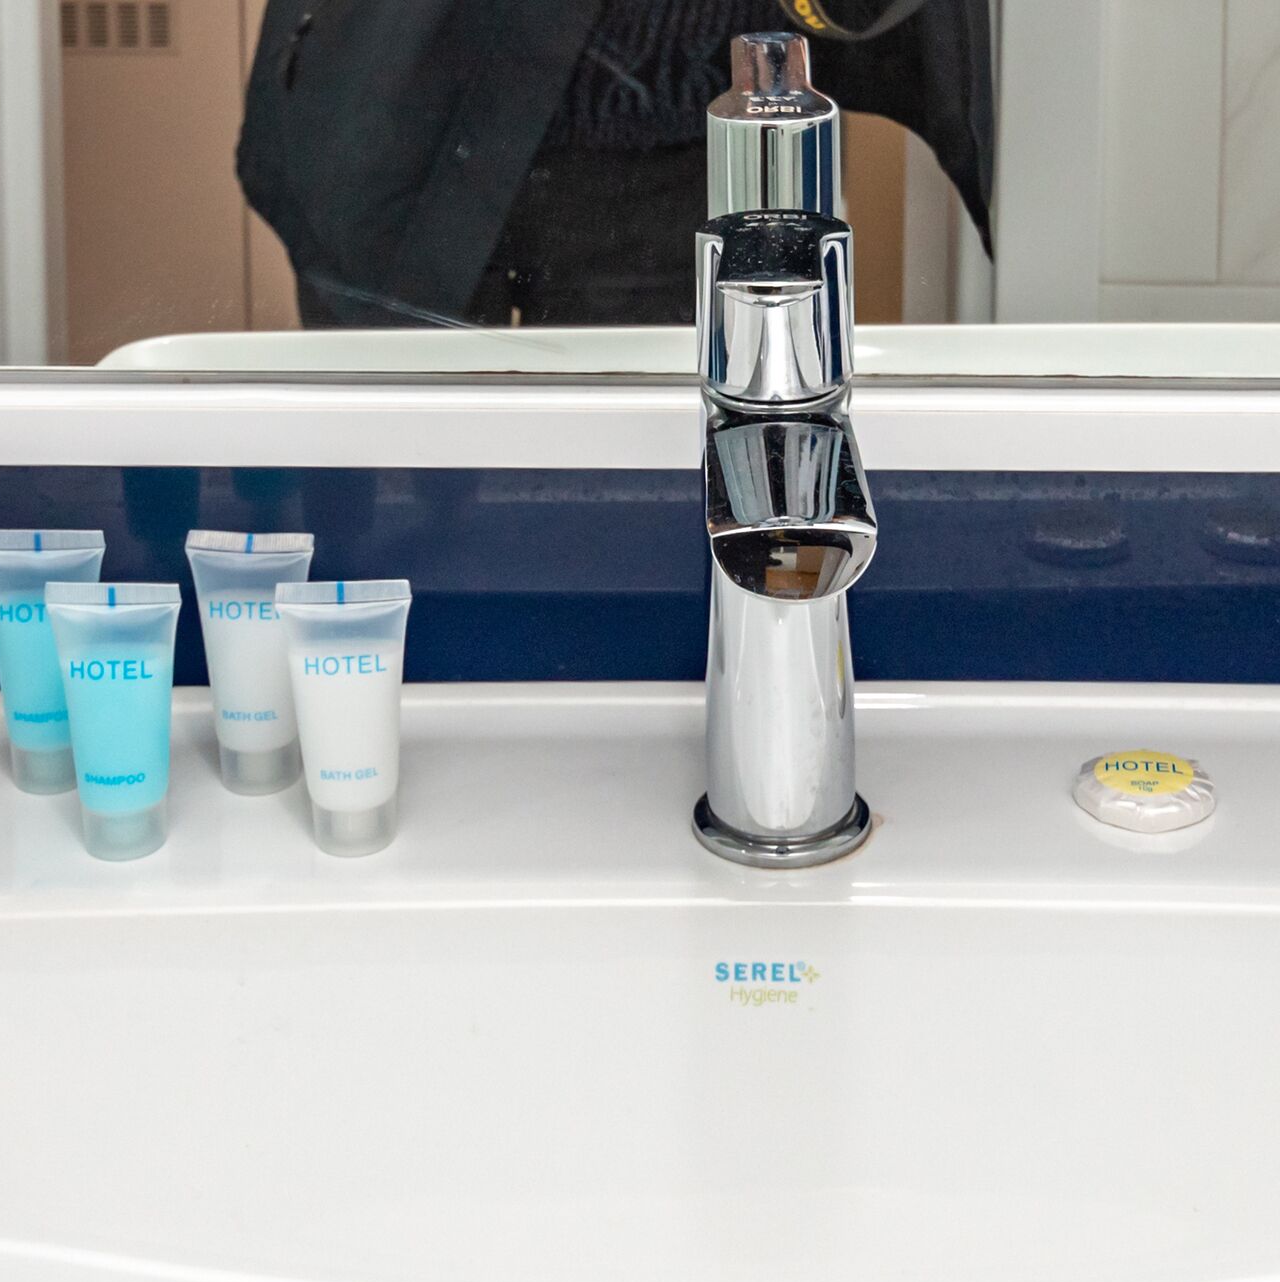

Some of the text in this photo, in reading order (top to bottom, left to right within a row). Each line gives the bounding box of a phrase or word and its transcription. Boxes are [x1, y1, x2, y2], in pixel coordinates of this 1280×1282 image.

[0, 603, 47, 623] HOT
[70, 660, 153, 680] HOTEL
[304, 654, 387, 676] HOTEL
[222, 710, 278, 721] BATH GEL
[320, 767, 379, 781] BATH GEL
[1105, 760, 1184, 775] HOTEL
[84, 772, 146, 785] SHAMPOO
[729, 985, 799, 1007] Hygiene
